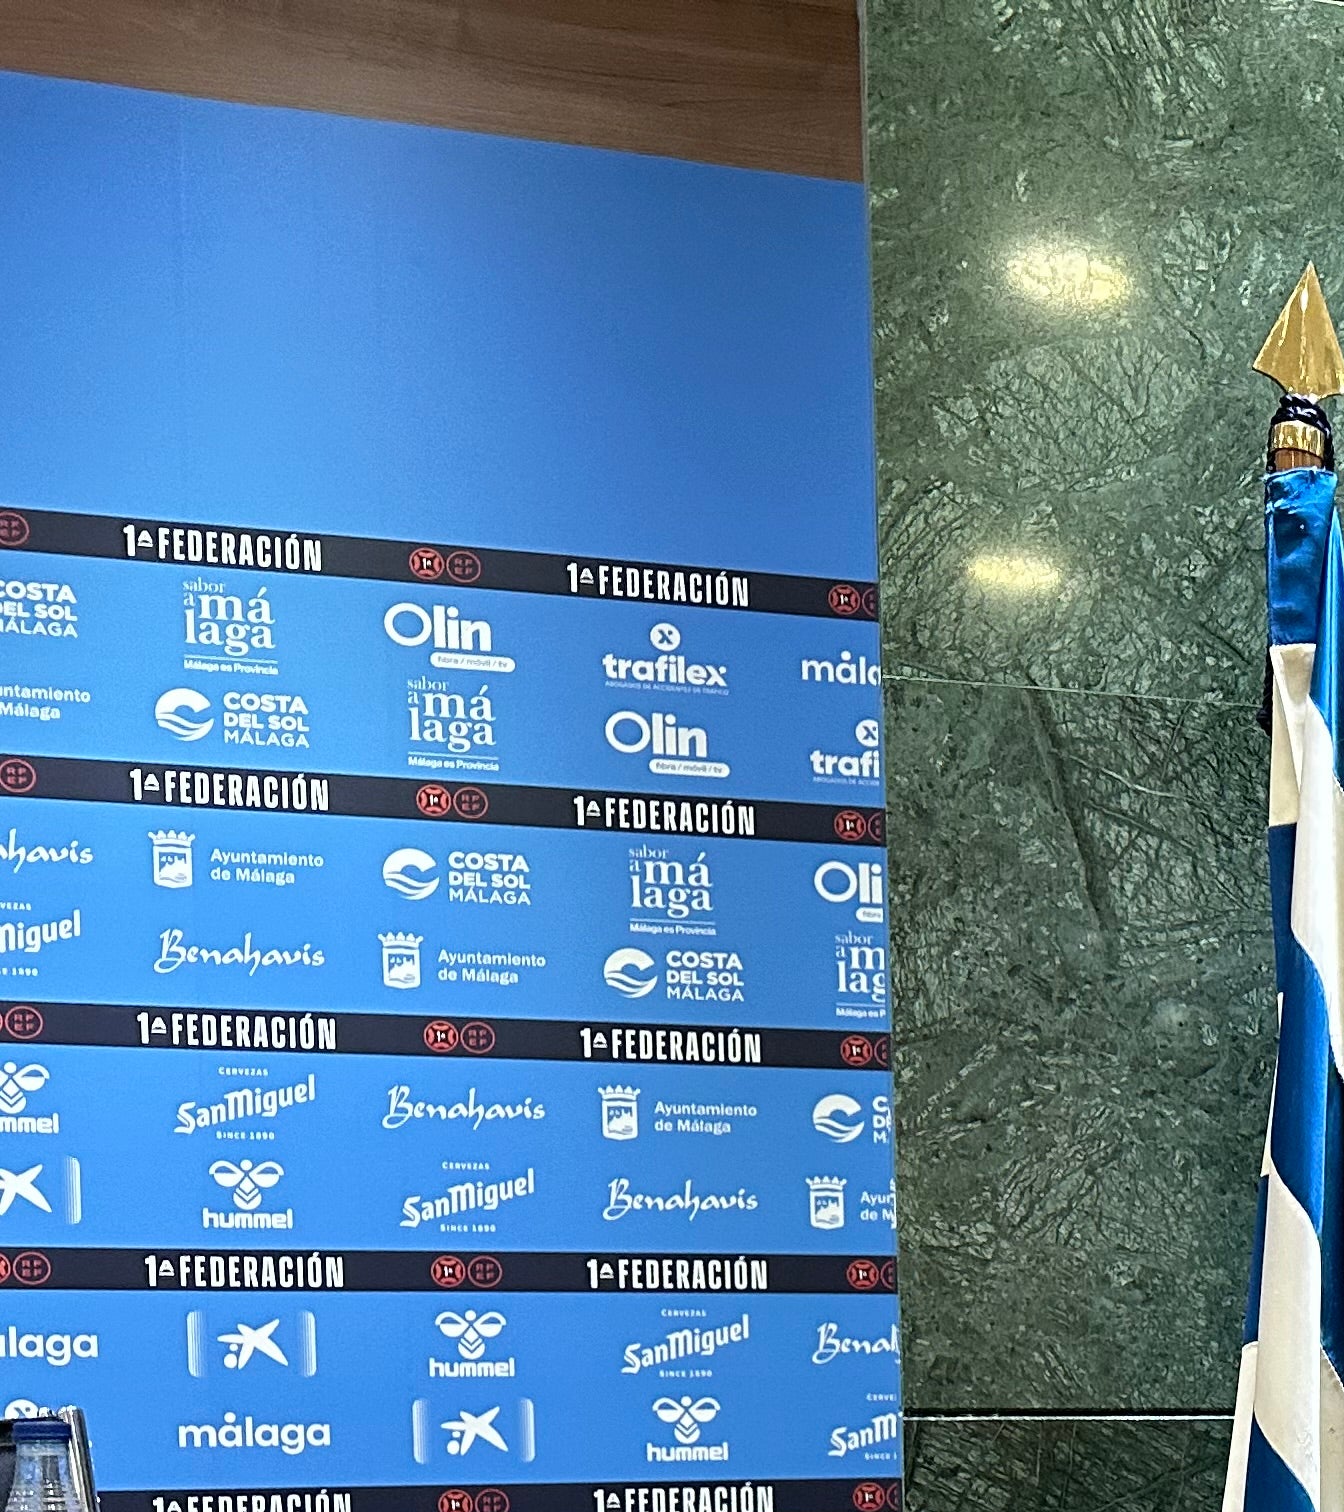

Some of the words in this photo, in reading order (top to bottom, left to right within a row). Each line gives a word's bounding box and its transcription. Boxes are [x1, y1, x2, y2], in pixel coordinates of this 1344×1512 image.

[158, 527, 323, 572] FEDERACIÓN
[599, 566, 748, 606] FEDERACIÓN
[0, 601, 30, 619] EL
[35, 604, 77, 621] SOL
[186, 607, 275, 658] laga
[384, 603, 491, 651] Olin
[603, 654, 726, 688] trafilex
[224, 692, 308, 714] COSTA
[224, 712, 264, 731] DEL
[268, 715, 309, 731] SOL
[408, 707, 496, 754] laga
[224, 725, 309, 748] MÁLAGA
[606, 712, 707, 757] Olin
[164, 771, 329, 812] FEDERACIÓN
[605, 798, 755, 836] FEDERACIÓN
[211, 849, 323, 867] Ayuntamiento
[449, 852, 529, 872] COSTA
[211, 867, 230, 880] de
[236, 868, 295, 886] Málaga
[449, 871, 487, 889] DEL
[492, 874, 530, 889] SOL
[449, 886, 530, 905] MÁLAGA
[632, 873, 712, 920] laga
[154, 929, 324, 976] Benahavis
[438, 949, 545, 966] Ayuntamiento
[666, 951, 743, 970] COSTA
[438, 968, 457, 981] de
[462, 968, 518, 985] Málaga
[667, 970, 703, 987] DEL
[707, 972, 744, 986] SOL
[667, 985, 744, 1001] MÁLAGA
[172, 1013, 335, 1049] FEDERACIÓN
[612, 1029, 760, 1062] FEDERACIÓN
[383, 1086, 545, 1130] Benahavis
[655, 1101, 757, 1116] Ayuntamiento
[655, 1119, 672, 1131] de
[678, 1119, 730, 1135] Málaga
[603, 1179, 757, 1220] Benahavis
[203, 1208, 293, 1228] hummel
[180, 1252, 343, 1287] FEDERACIÓN
[619, 1256, 767, 1289] FEDERACIÓN
[0, 1327, 98, 1365] laga
[430, 1358, 514, 1377] hummel
[647, 1442, 728, 1461] hummel
